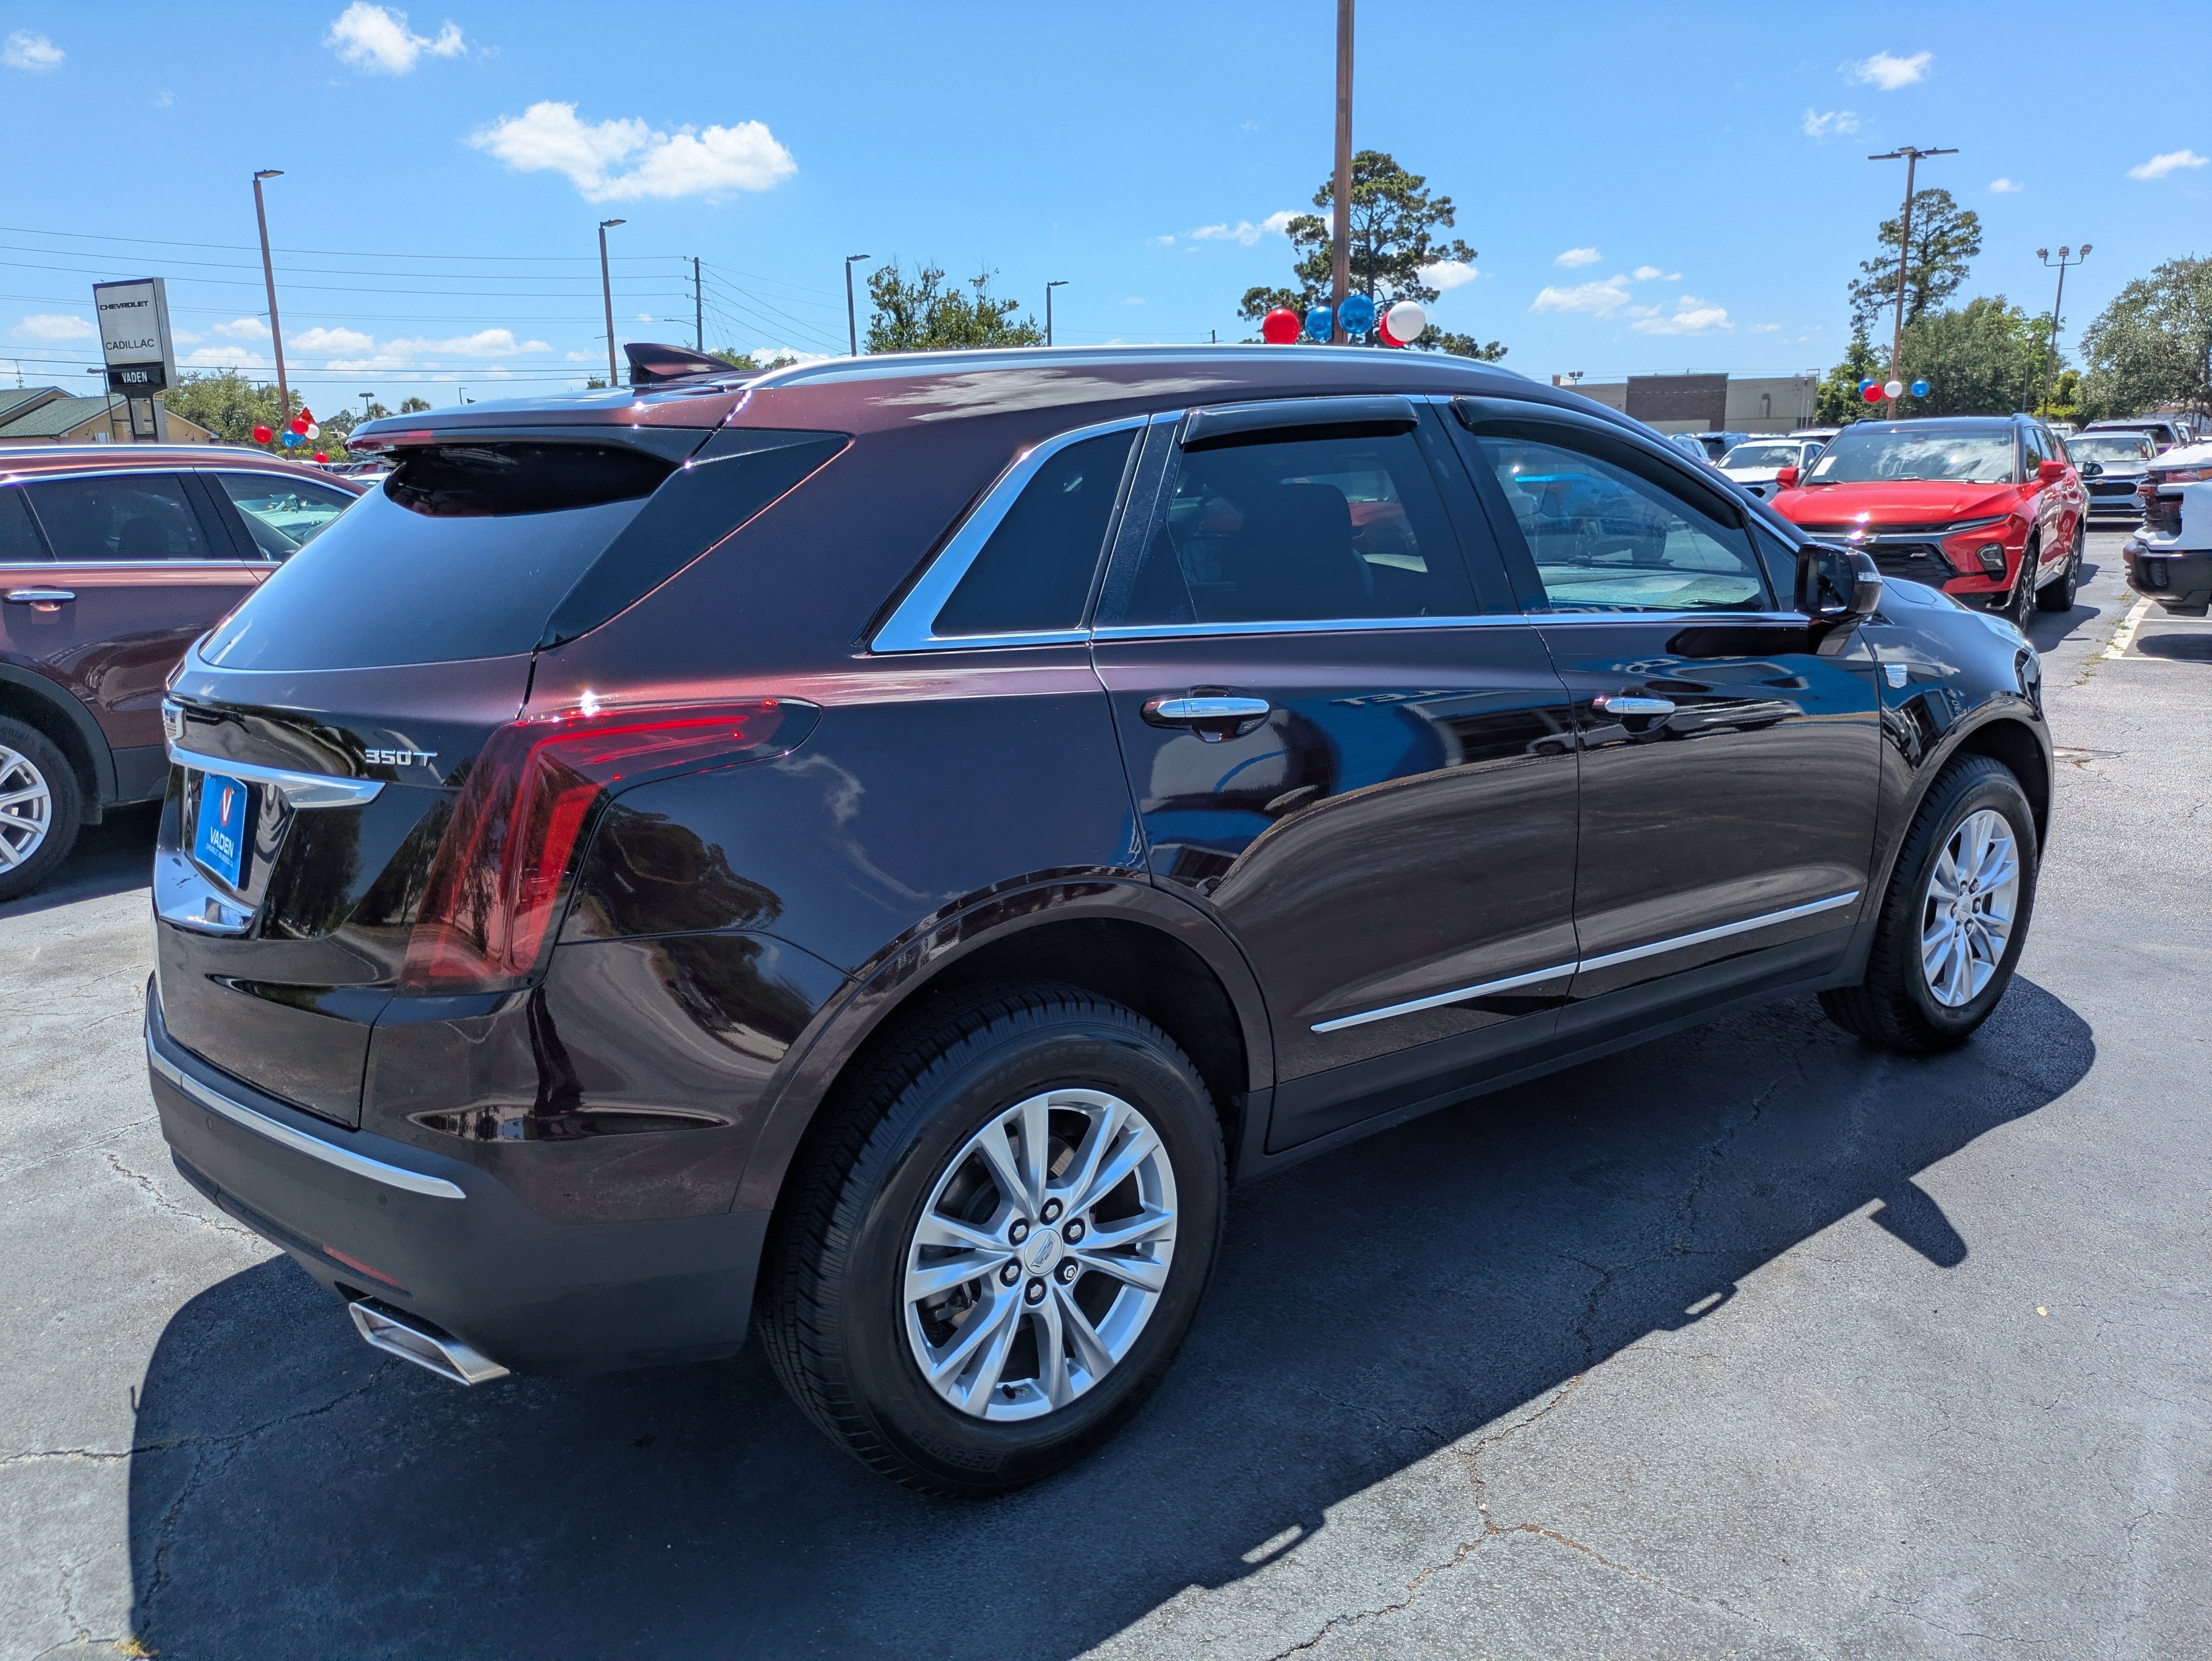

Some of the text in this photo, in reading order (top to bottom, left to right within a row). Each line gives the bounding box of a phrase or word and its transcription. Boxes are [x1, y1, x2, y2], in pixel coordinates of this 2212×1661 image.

[100, 300, 149, 310] CHEVROLET
[106, 338, 155, 350] CADILLAC
[122, 371, 148, 383] VADEN
[365, 749, 438, 766] 350T
[210, 826, 234, 858] VADEN
